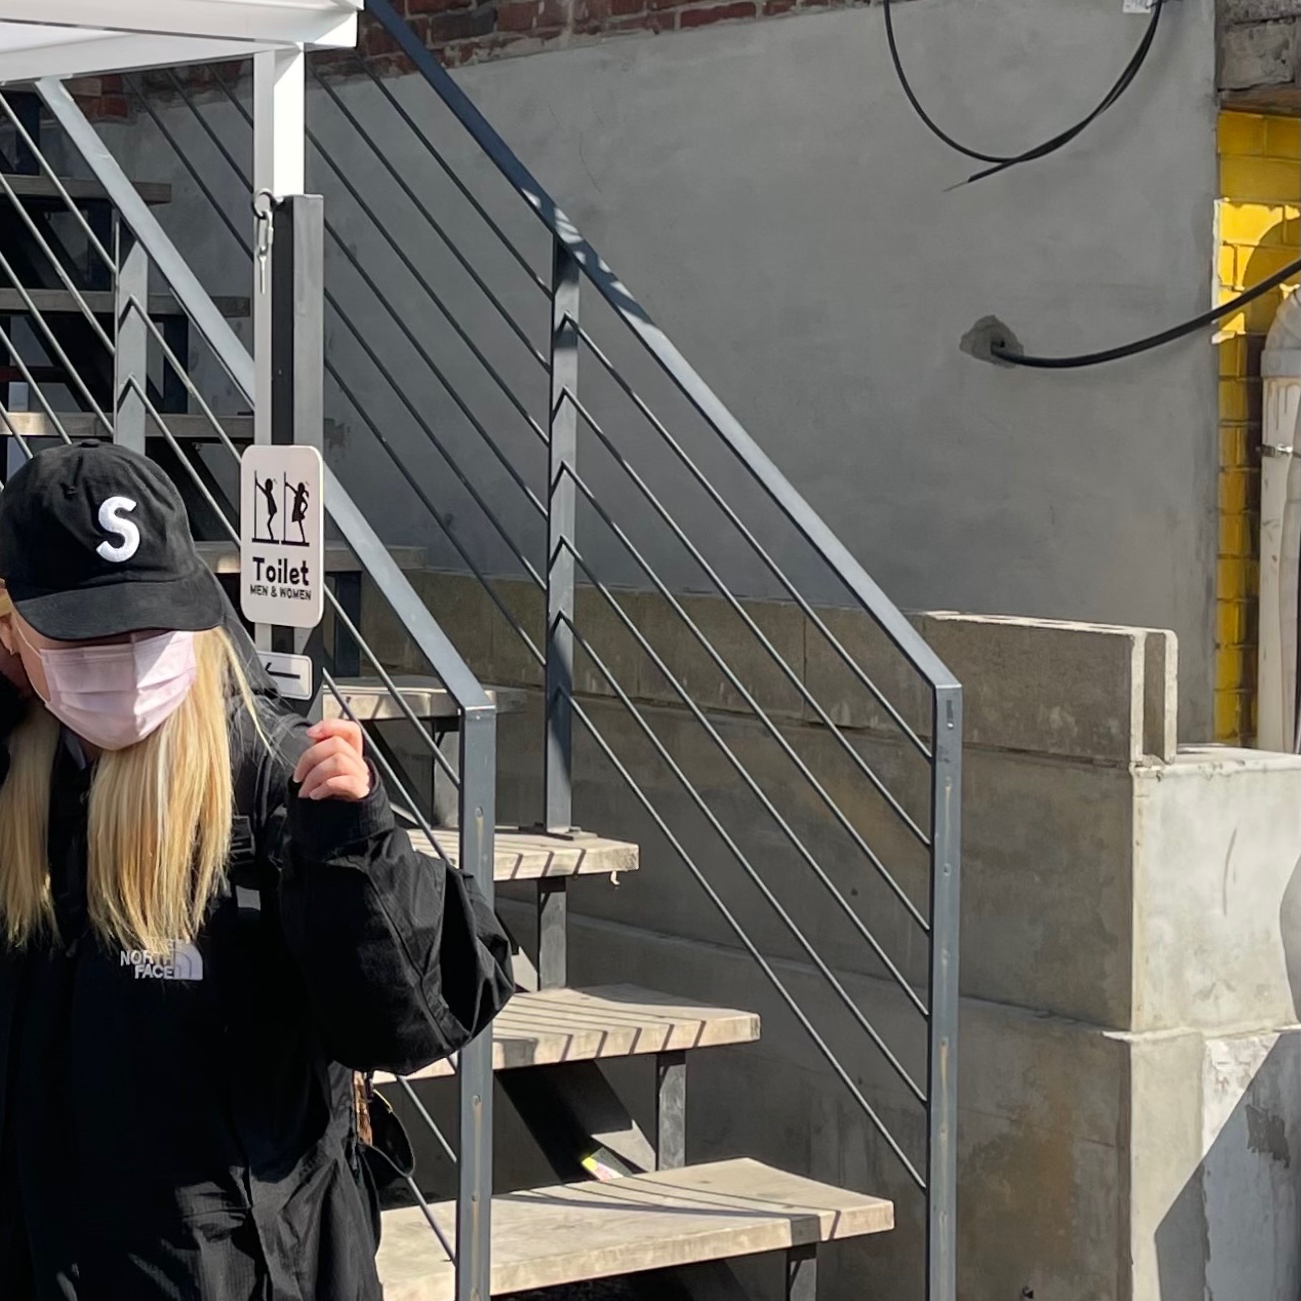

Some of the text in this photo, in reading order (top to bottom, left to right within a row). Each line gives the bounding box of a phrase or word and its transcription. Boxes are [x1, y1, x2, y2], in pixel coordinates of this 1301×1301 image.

[96, 496, 140, 562] S
[252, 556, 309, 586] Toilet
[250, 584, 311, 600] MEN & WOMEN
[134, 963, 174, 980] FACE
